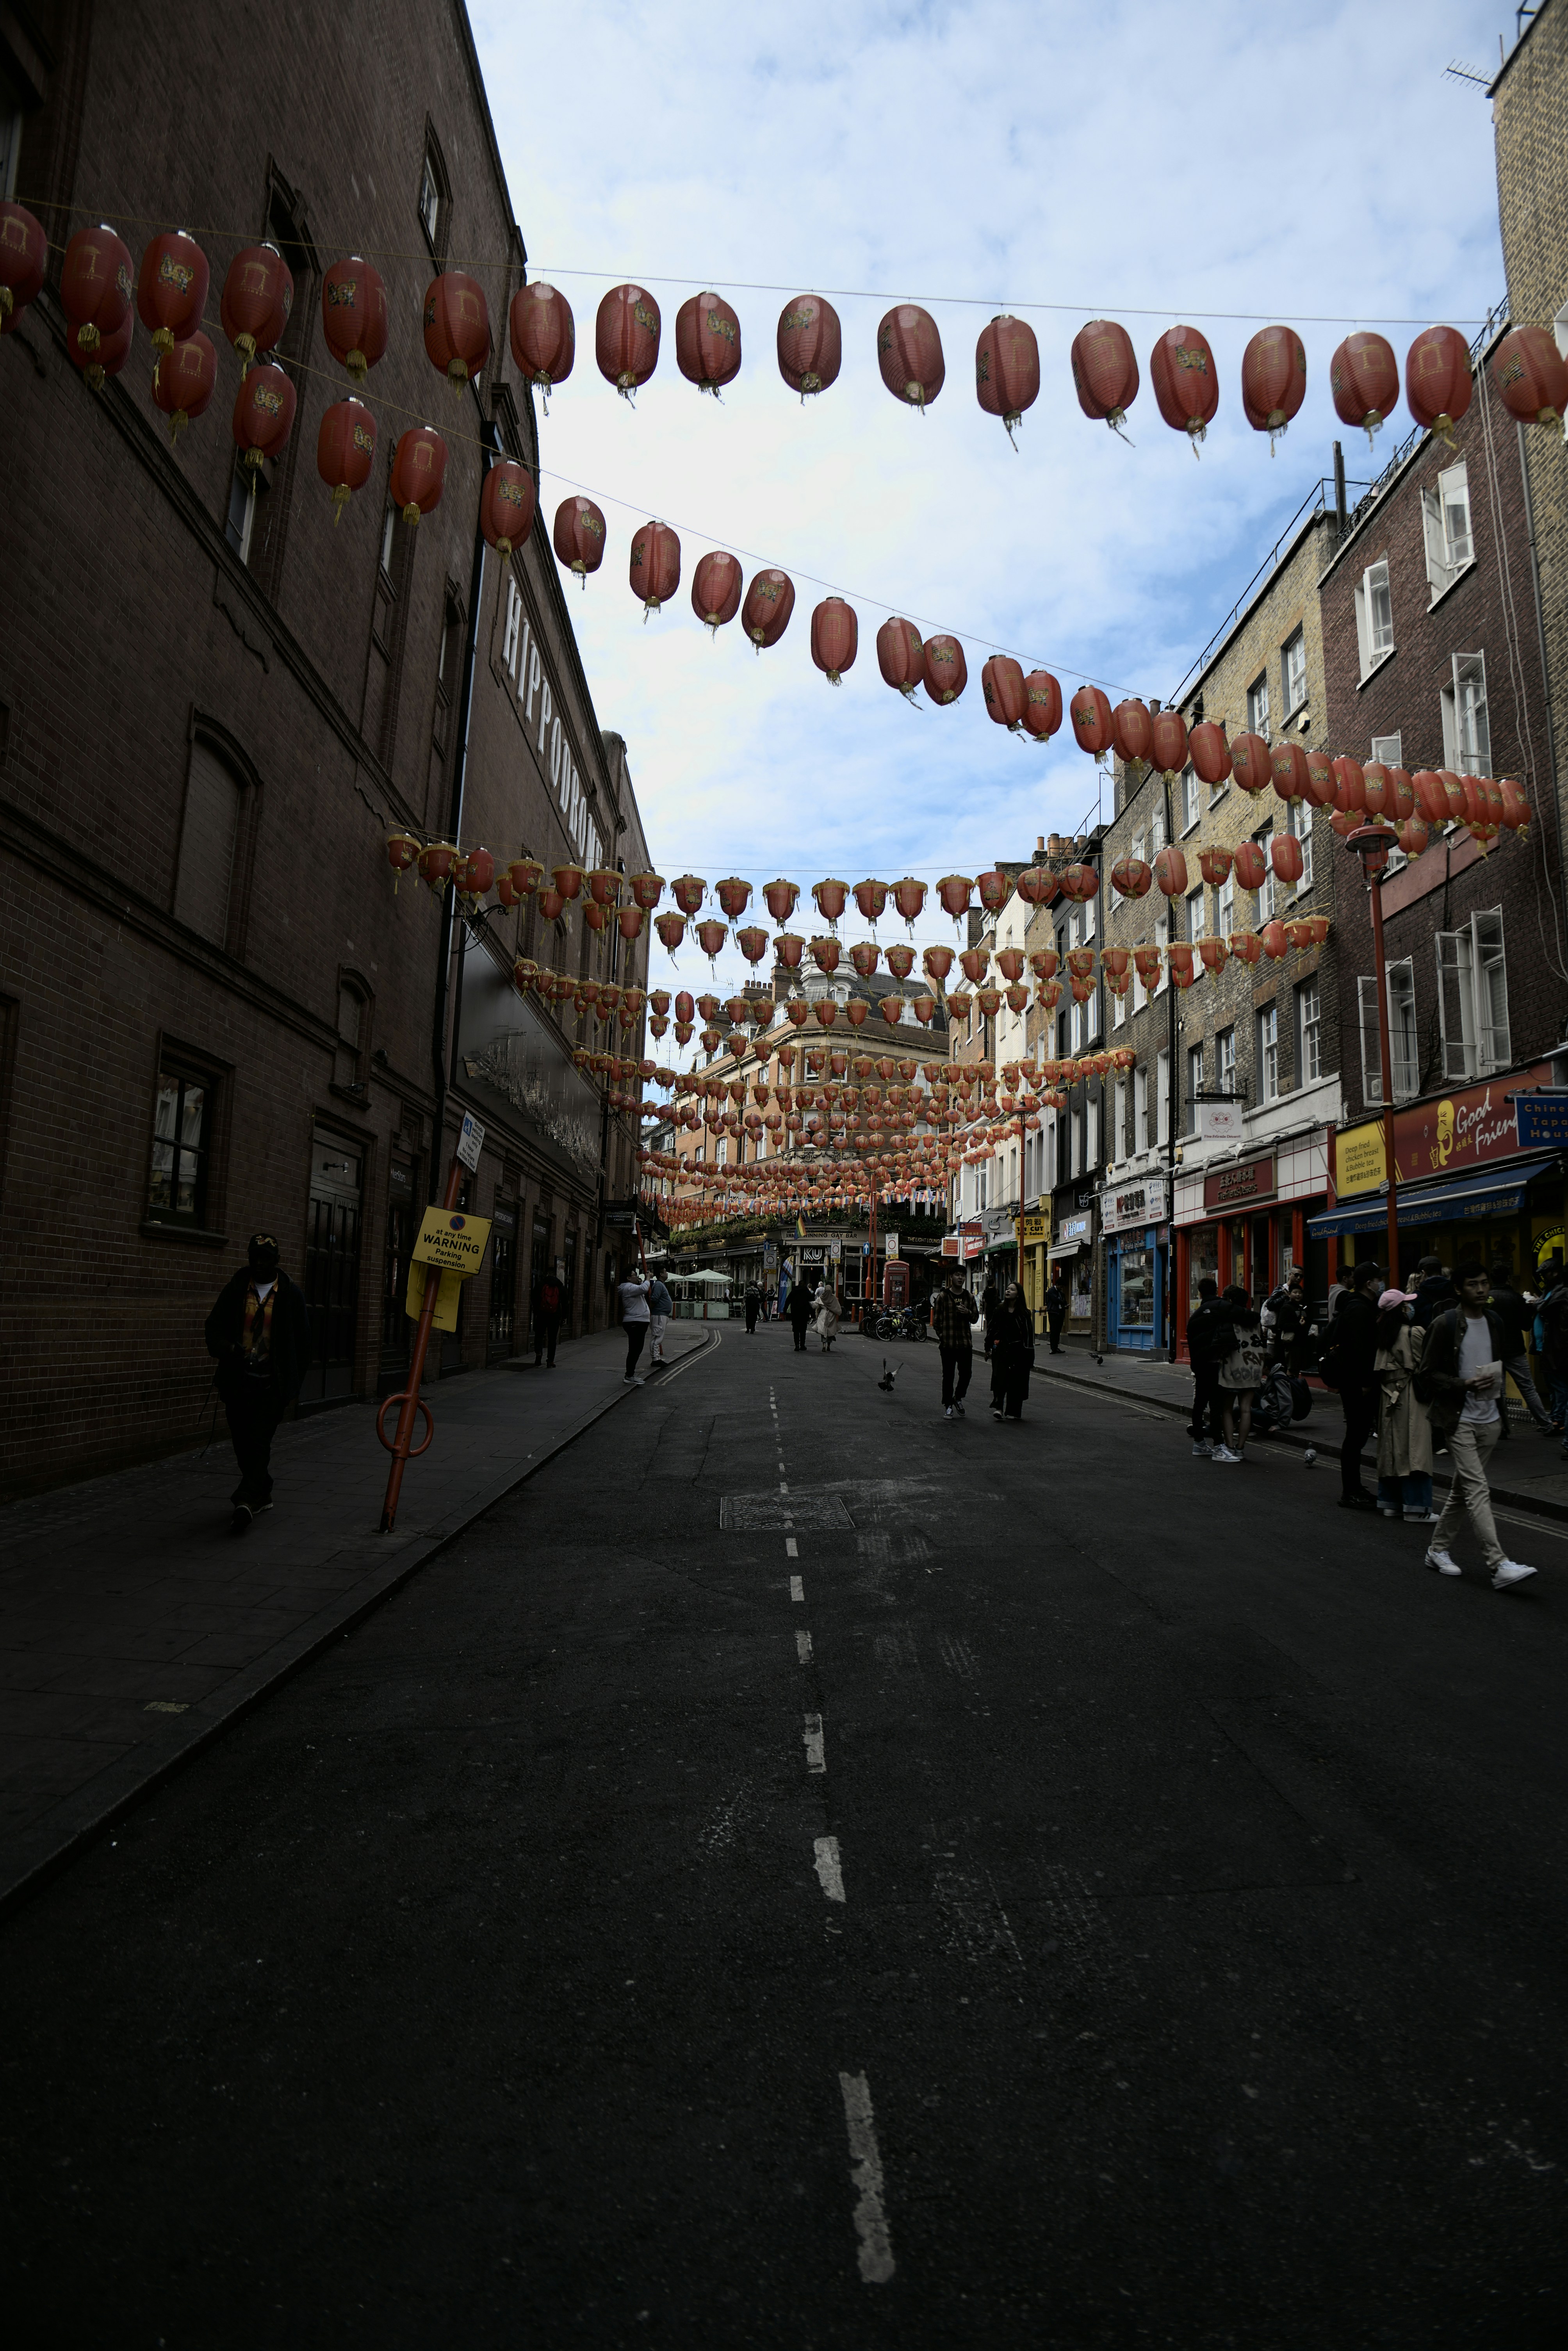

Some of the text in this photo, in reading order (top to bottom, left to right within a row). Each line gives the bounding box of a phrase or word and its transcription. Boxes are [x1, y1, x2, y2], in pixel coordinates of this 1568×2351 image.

[1456, 1087, 1492, 1134] Good
[1524, 1104, 1568, 1112] Chine
[472, 1127, 483, 1139] vehicles
[474, 1122, 483, 1133] Goods
[471, 1133, 481, 1145] loading
[1345, 1140, 1370, 1154] Deep fried
[459, 1151, 467, 1161] within
[1345, 1148, 1379, 1163] chicken breast
[458, 1233, 472, 1241] time
[1312, 1225, 1338, 1237] Good Friend
[424, 1234, 480, 1254] WARNING
[1533, 1238, 1545, 1253] THE
[435, 1248, 462, 1261] Parking
[804, 1247, 822, 1260] KU
[427, 1256, 466, 1269] suspension
